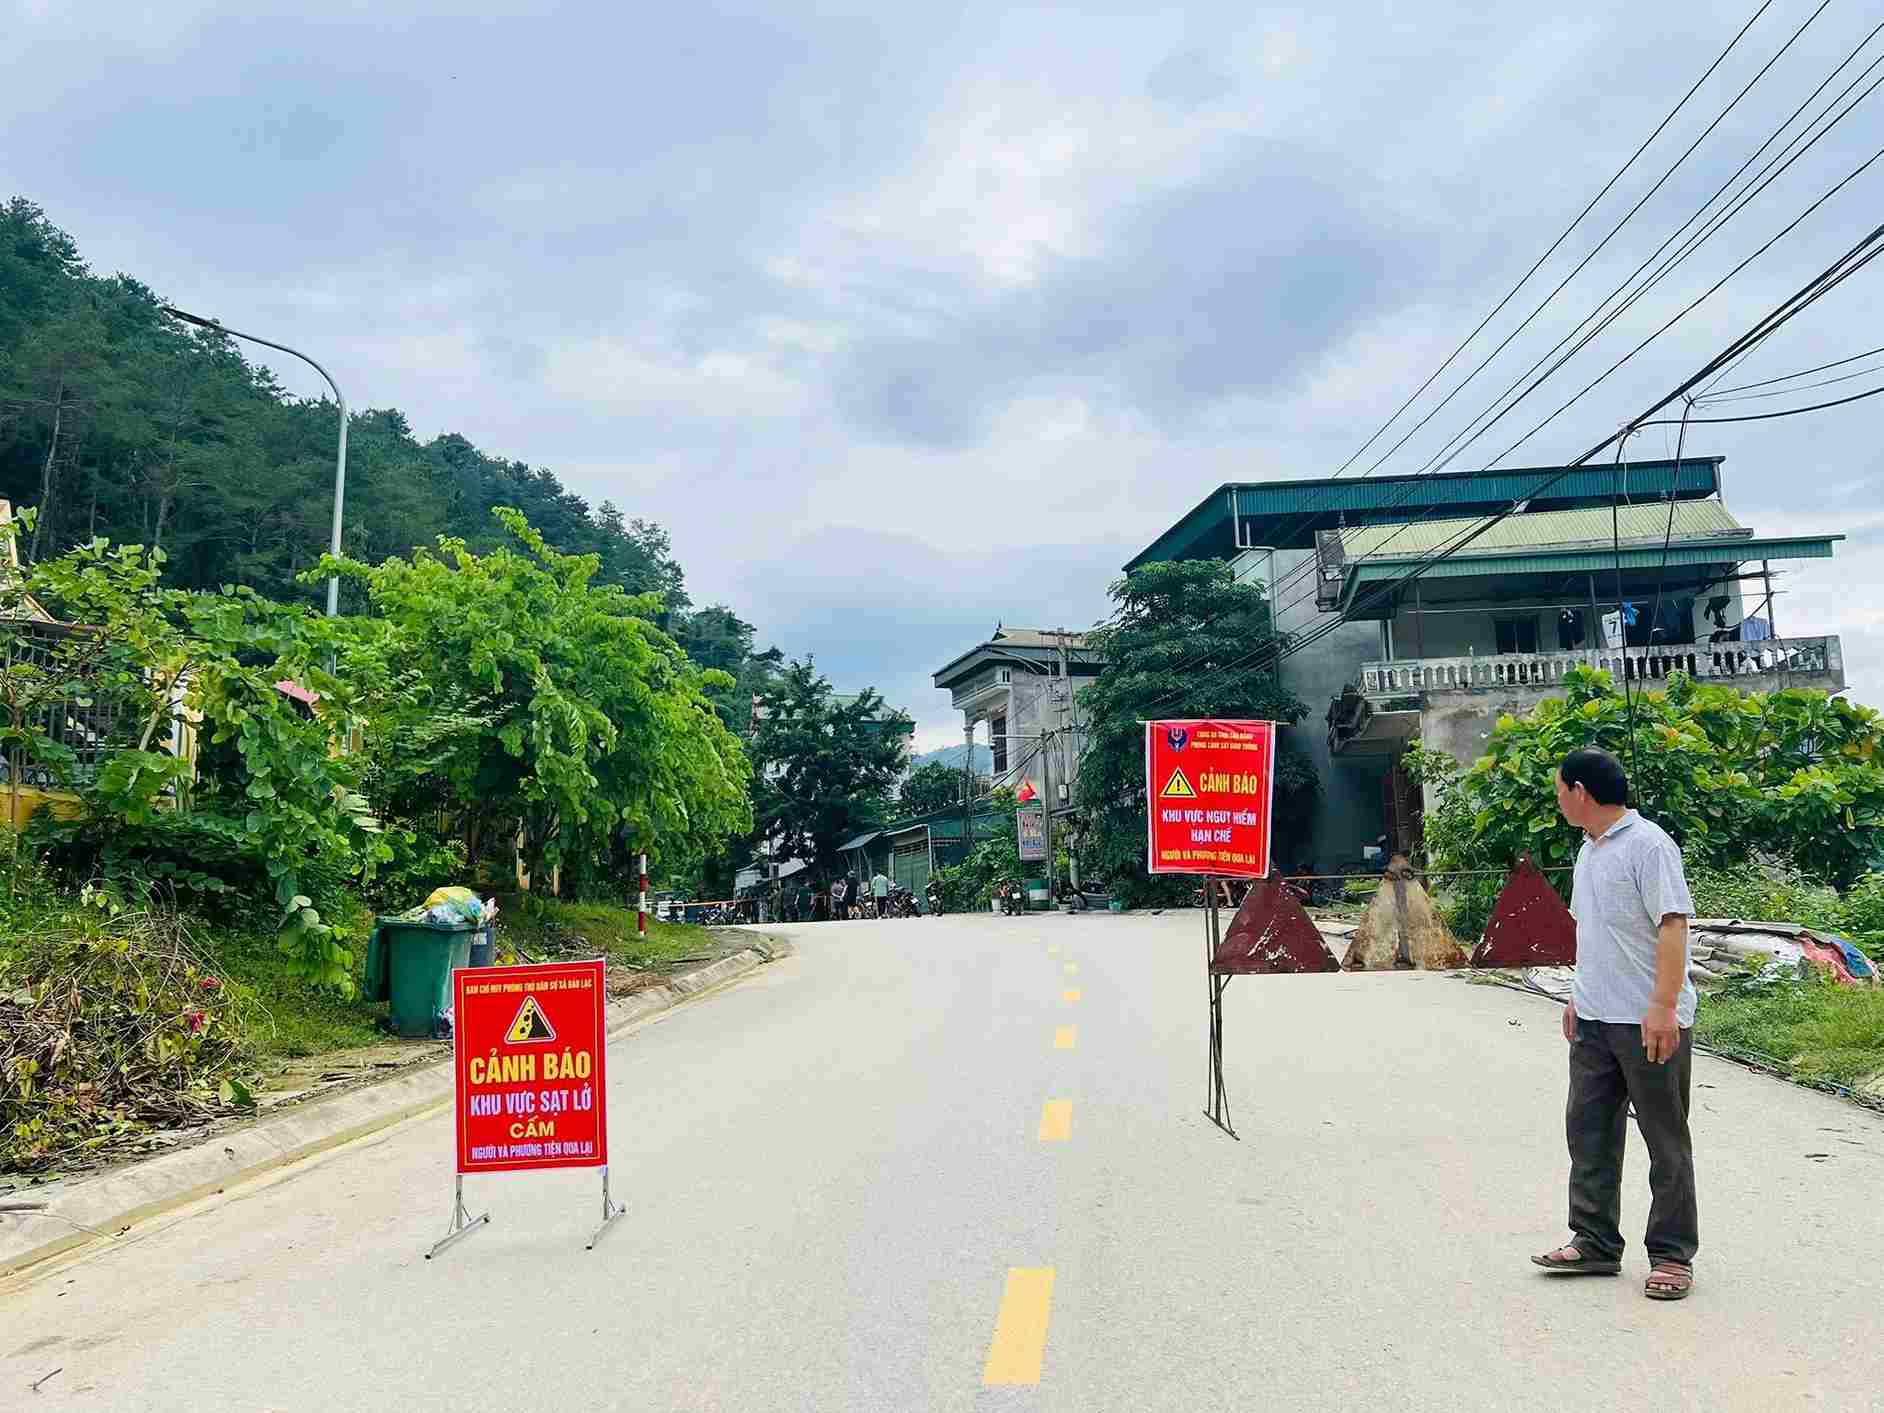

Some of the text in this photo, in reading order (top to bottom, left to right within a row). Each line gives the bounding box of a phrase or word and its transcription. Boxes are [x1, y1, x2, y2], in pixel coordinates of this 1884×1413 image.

[1200, 766, 1258, 794] CẢNH BÁO
[1162, 809, 1182, 822] KHU
[1184, 808, 1204, 826] VỰC
[1232, 808, 1256, 826] HIỂM
[1191, 826, 1232, 844] HẠN CHẾ
[470, 1046, 591, 1085] CẢNH BÁO
[471, 1082, 592, 1118] KHU VỰC SẠT LỞ
[510, 1115, 555, 1139] CẤM
[472, 1140, 592, 1160] NGƯỜI VÀ PHƯƠNG TIỆN QUA LẠI
